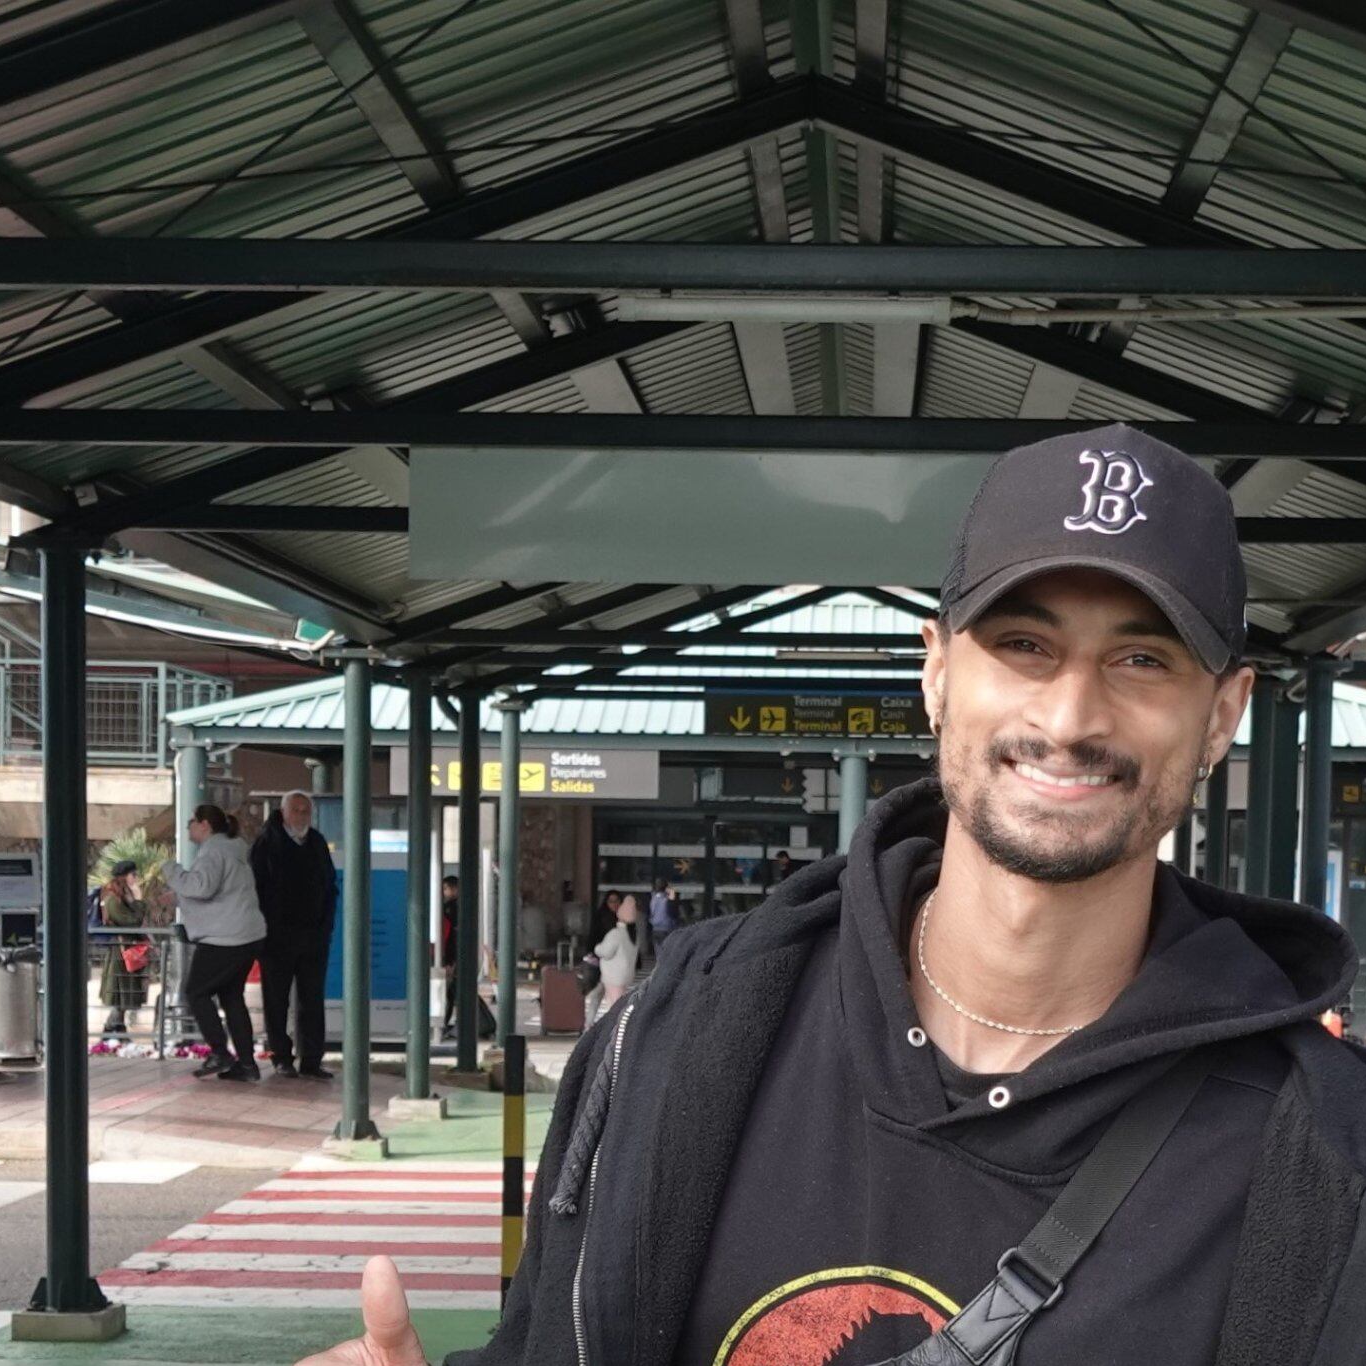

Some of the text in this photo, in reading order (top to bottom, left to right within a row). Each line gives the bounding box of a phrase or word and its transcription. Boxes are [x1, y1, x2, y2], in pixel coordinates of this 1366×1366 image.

[1064, 449, 1154, 534] B
[794, 696, 842, 707] Terminal
[881, 697, 913, 708] Caixa
[794, 708, 835, 719] Terminal
[794, 720, 843, 731] Terminal
[880, 721, 906, 733] Caja
[550, 752, 601, 766] Sortides
[550, 767, 607, 779] Departures
[550, 780, 595, 793] Salidas
